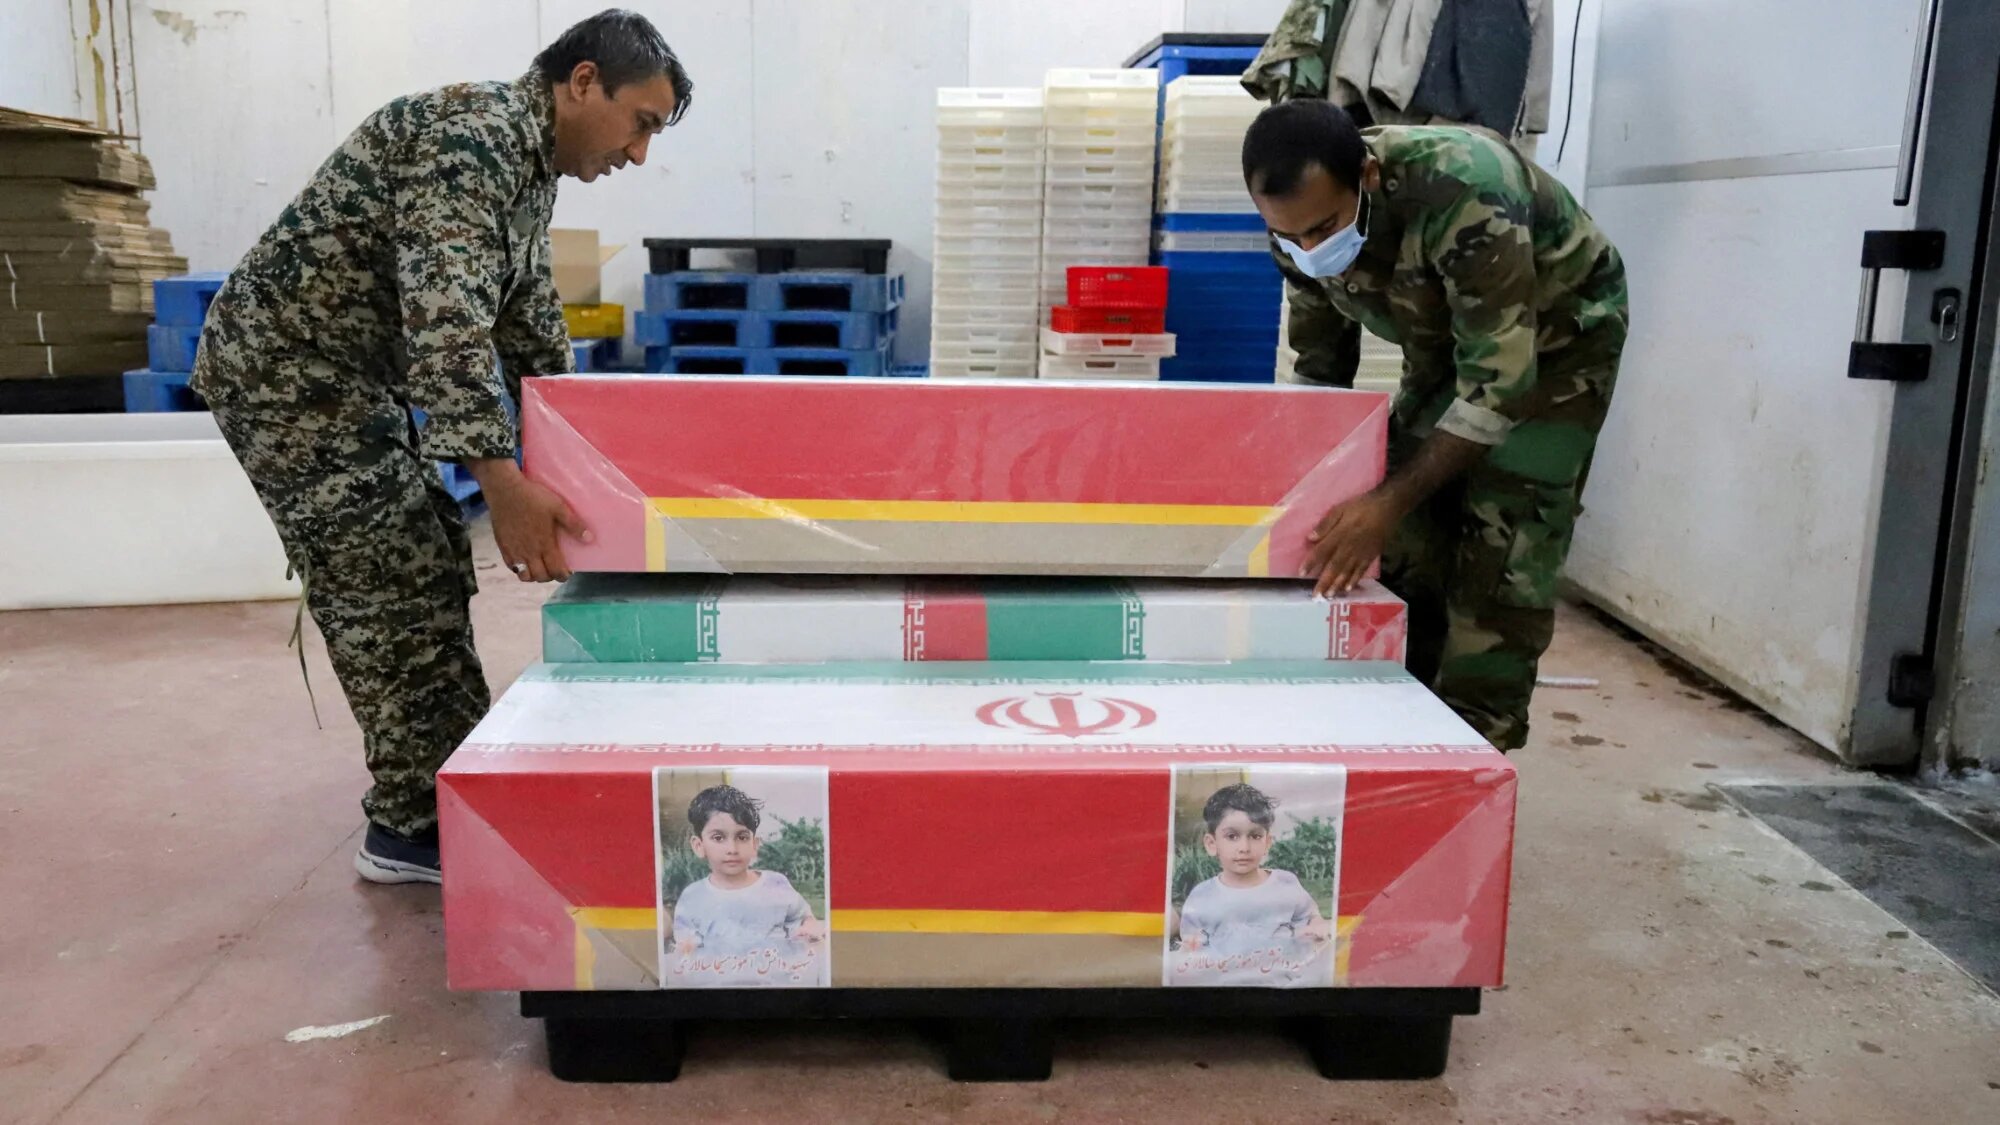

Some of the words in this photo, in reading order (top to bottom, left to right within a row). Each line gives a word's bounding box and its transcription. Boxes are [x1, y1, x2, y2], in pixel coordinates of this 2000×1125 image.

[731, 950, 758, 970] آموز
[757, 949, 786, 975] دانش
[788, 950, 815, 980] شهید
[1261, 947, 1288, 973] دانش
